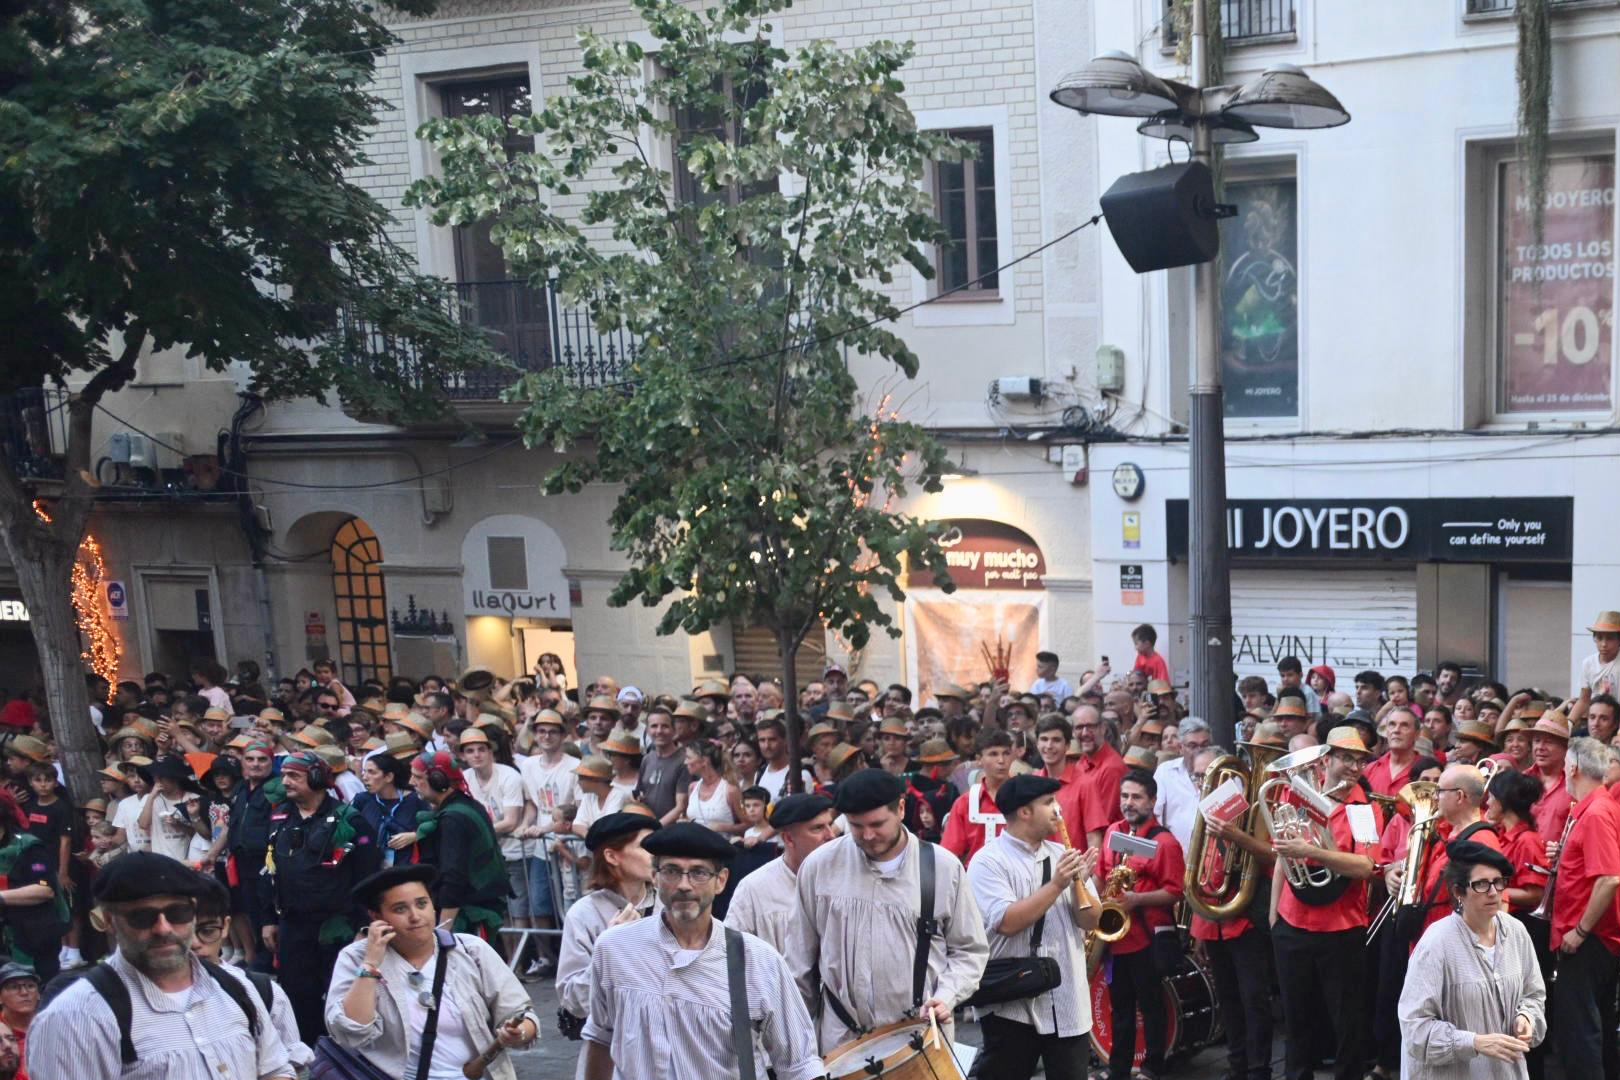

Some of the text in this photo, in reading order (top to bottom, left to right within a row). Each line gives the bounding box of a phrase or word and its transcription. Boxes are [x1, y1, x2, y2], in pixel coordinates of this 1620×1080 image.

[1545, 188, 1615, 209] JOYERO
[1577, 241, 1612, 258] LOS
[1512, 262, 1615, 282] PRODUCTOS
[1254, 506, 1409, 549] JOYERO
[1498, 519, 1542, 533] Only you
[1449, 533, 1547, 548] can define yourself
[945, 549, 1039, 570] muy mucho
